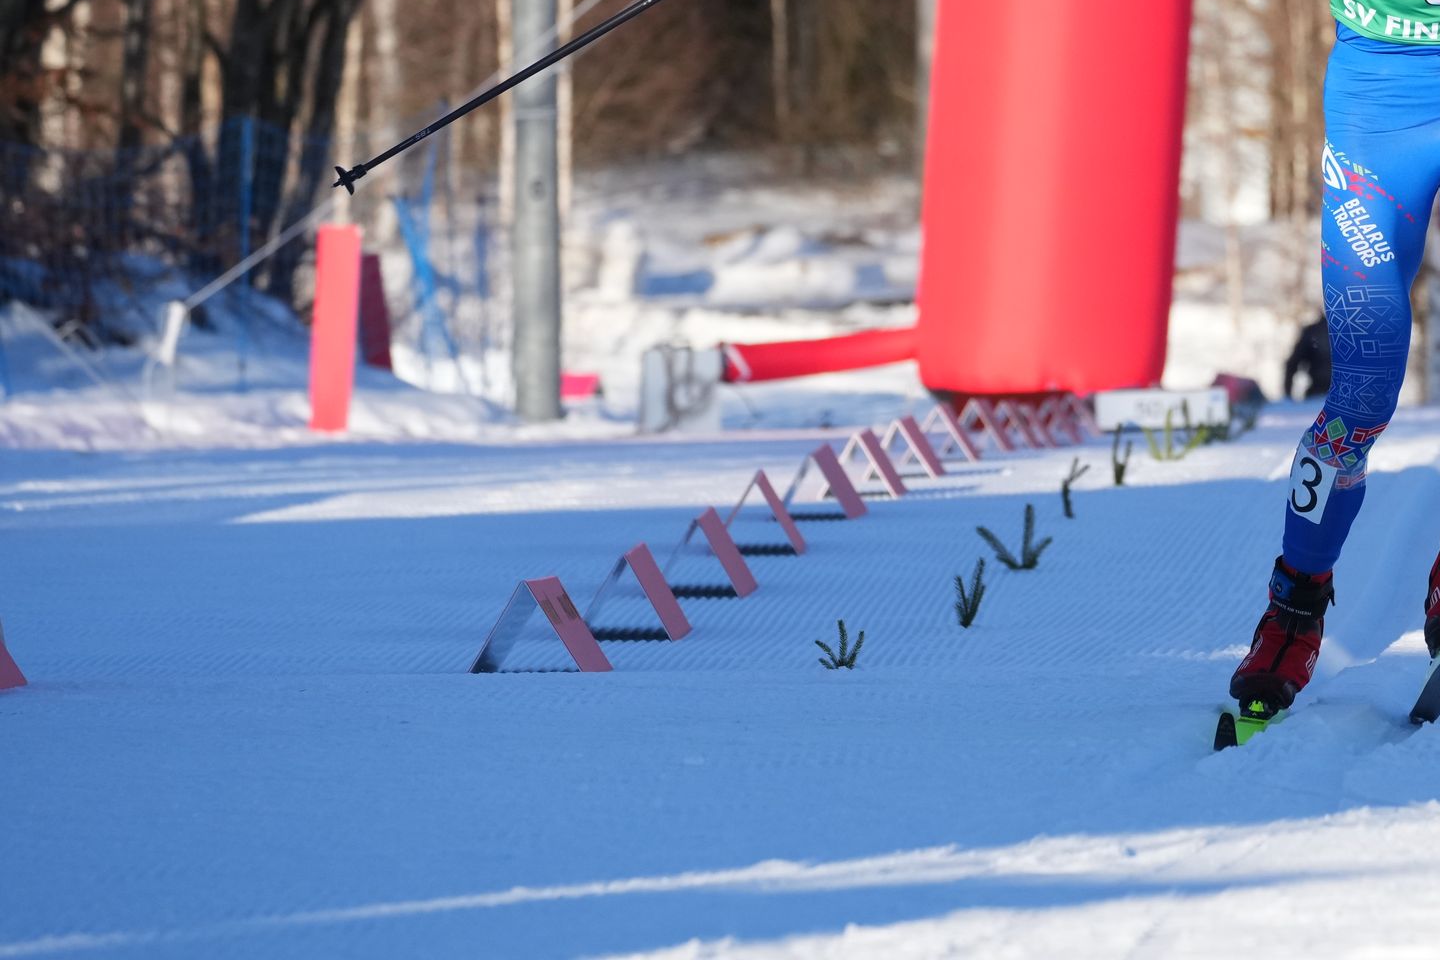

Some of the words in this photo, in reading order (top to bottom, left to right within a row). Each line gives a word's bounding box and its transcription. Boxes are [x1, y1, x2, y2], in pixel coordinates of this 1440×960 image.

[1332, 204, 1381, 268] TRACTORS
[1344, 198, 1395, 263] BELARUS
[1291, 456, 1323, 513] 3
